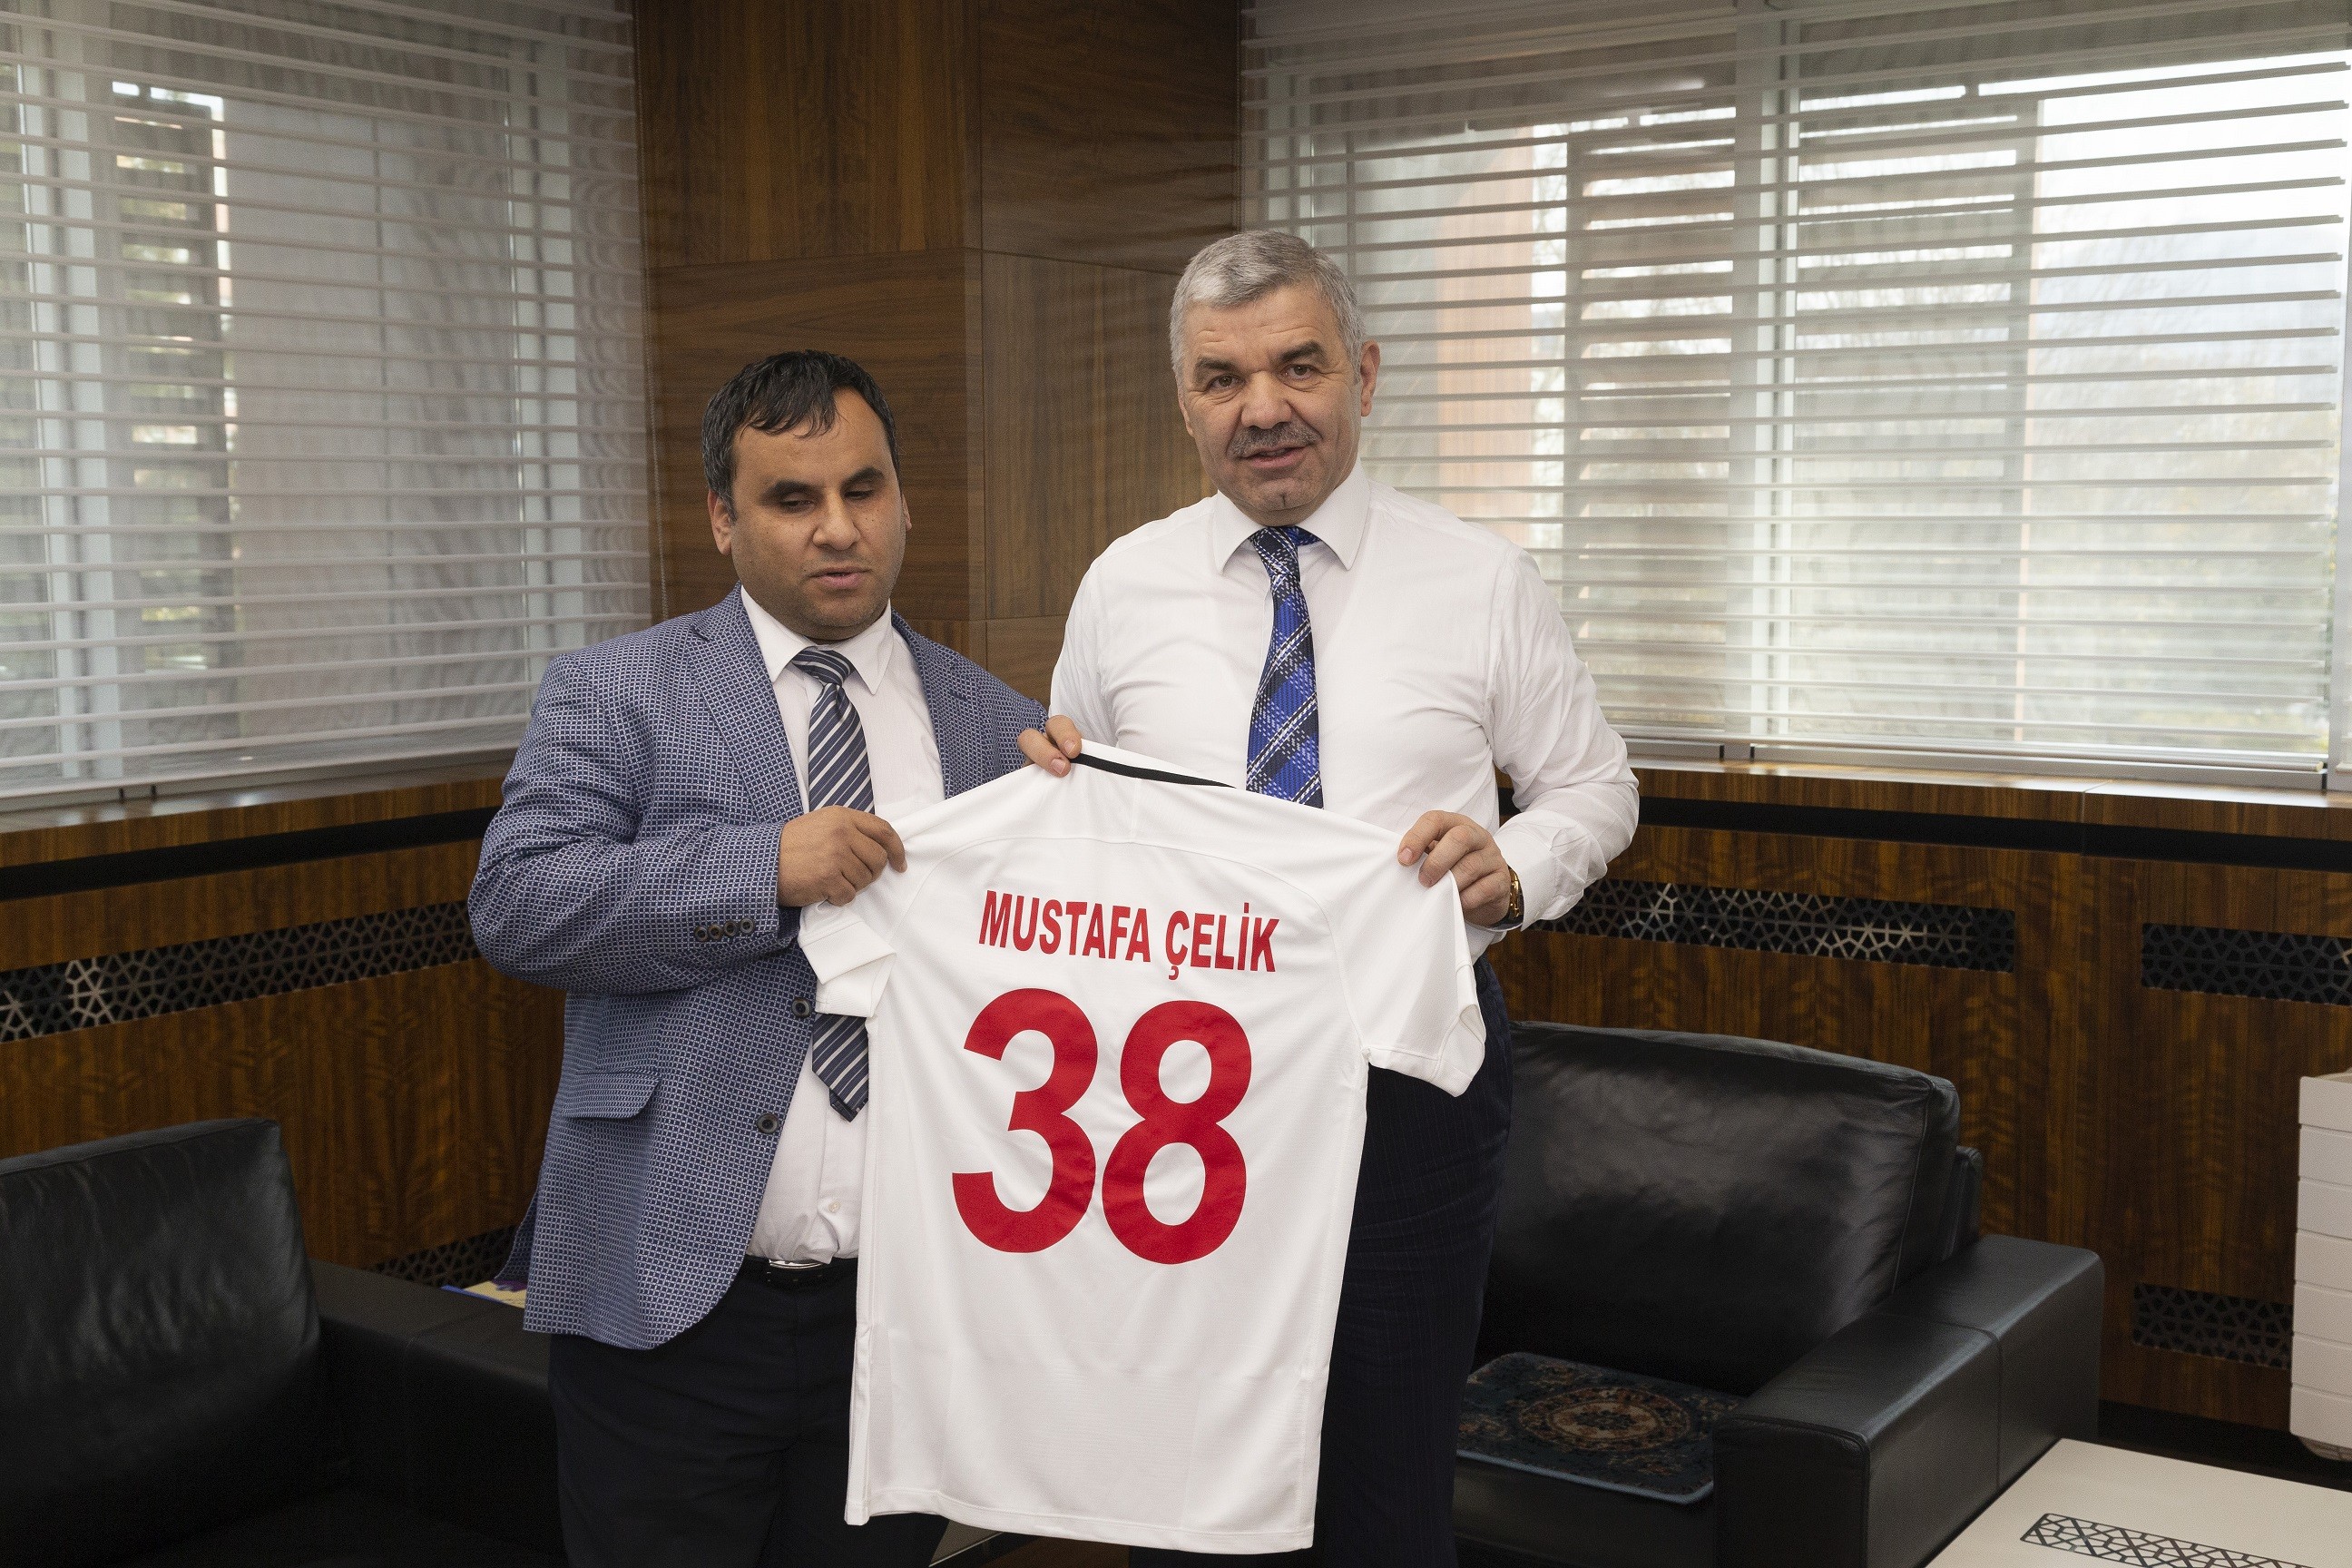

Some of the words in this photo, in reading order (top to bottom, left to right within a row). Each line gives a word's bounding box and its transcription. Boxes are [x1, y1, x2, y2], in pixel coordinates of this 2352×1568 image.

[978, 890, 1151, 963] MUSTAFA
[1165, 902, 1280, 981] ÇELİK
[952, 987, 1252, 1265] 38
